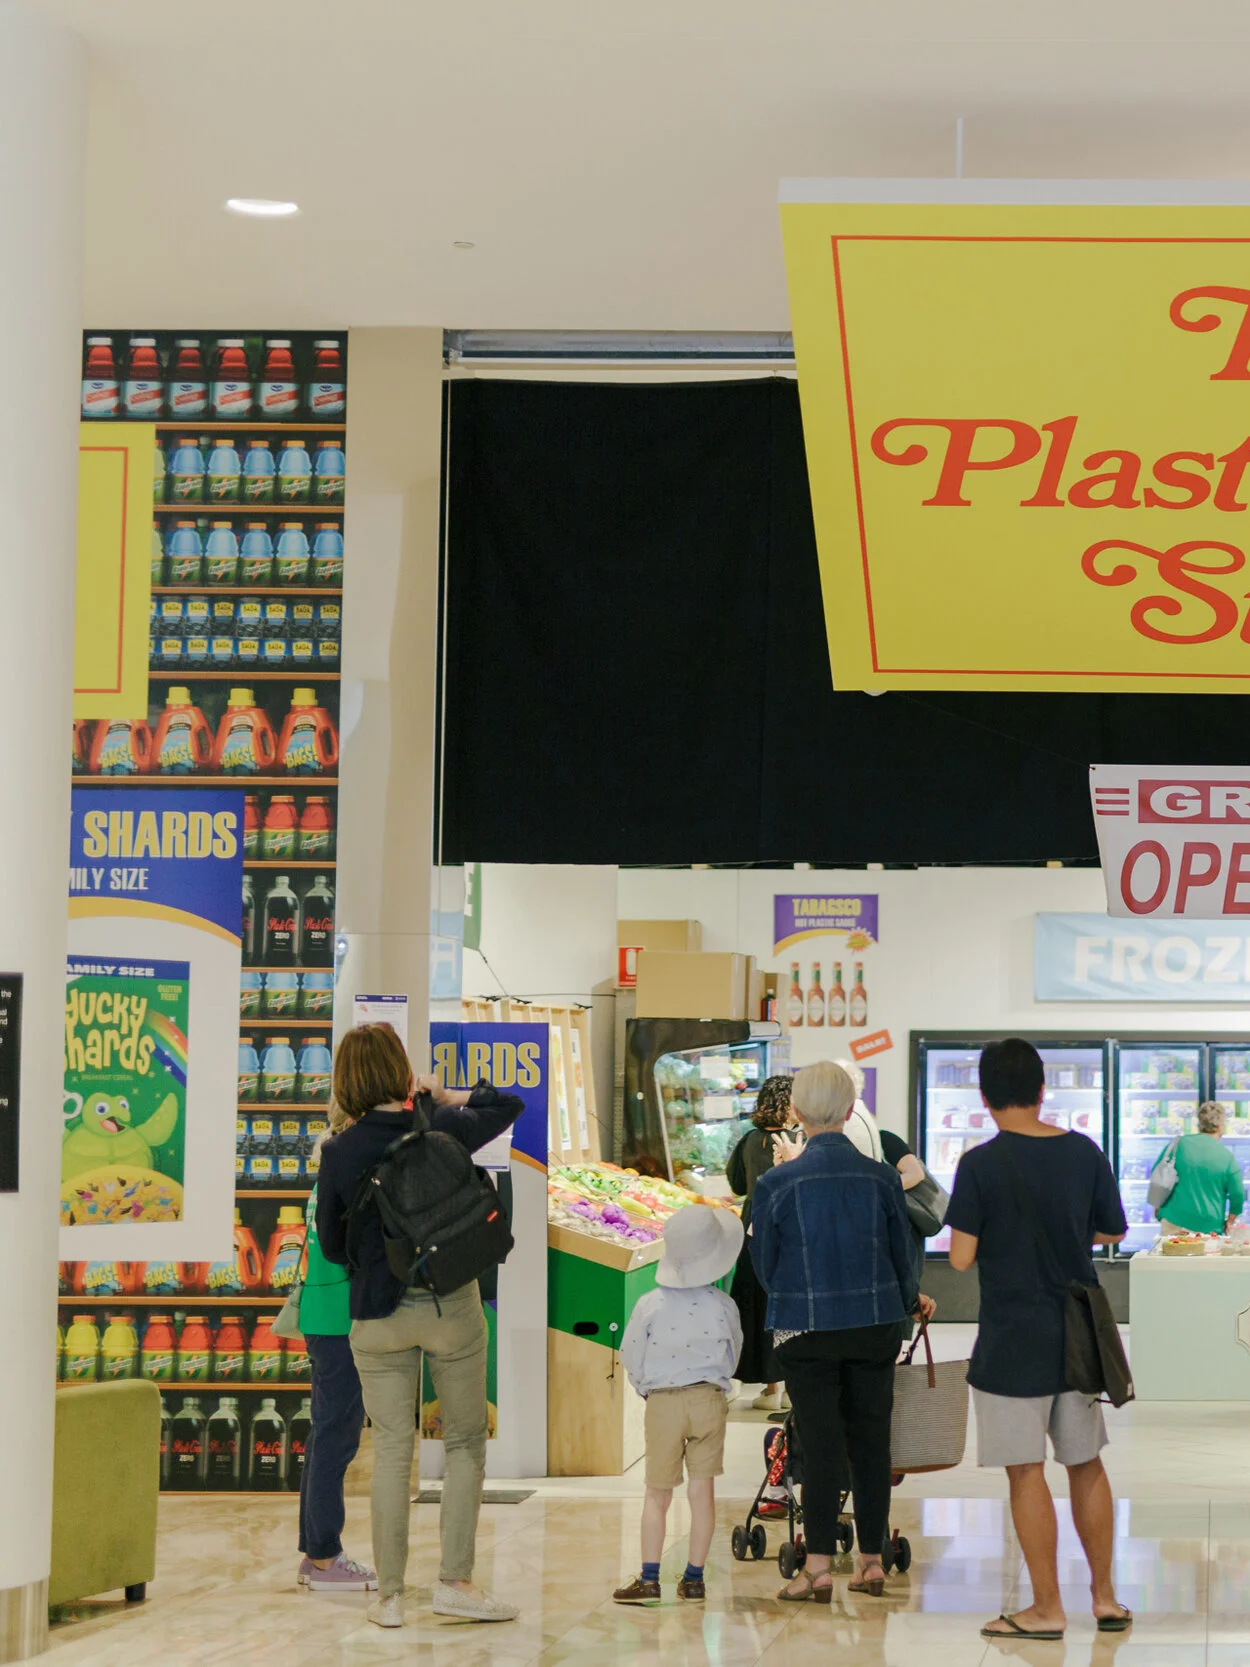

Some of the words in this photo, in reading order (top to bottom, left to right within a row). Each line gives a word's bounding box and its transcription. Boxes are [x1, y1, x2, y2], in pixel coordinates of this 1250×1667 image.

[84, 810, 238, 859] SHARDS
[69, 867, 105, 890] MILY
[110, 867, 149, 891] SIZE
[274, 931, 290, 939] ZERO
[310, 931, 326, 939] ZERO
[66, 964, 116, 975] AMILY
[118, 967, 155, 976] SIZE
[1, 990, 12, 998] the
[64, 1021, 156, 1076] hards
